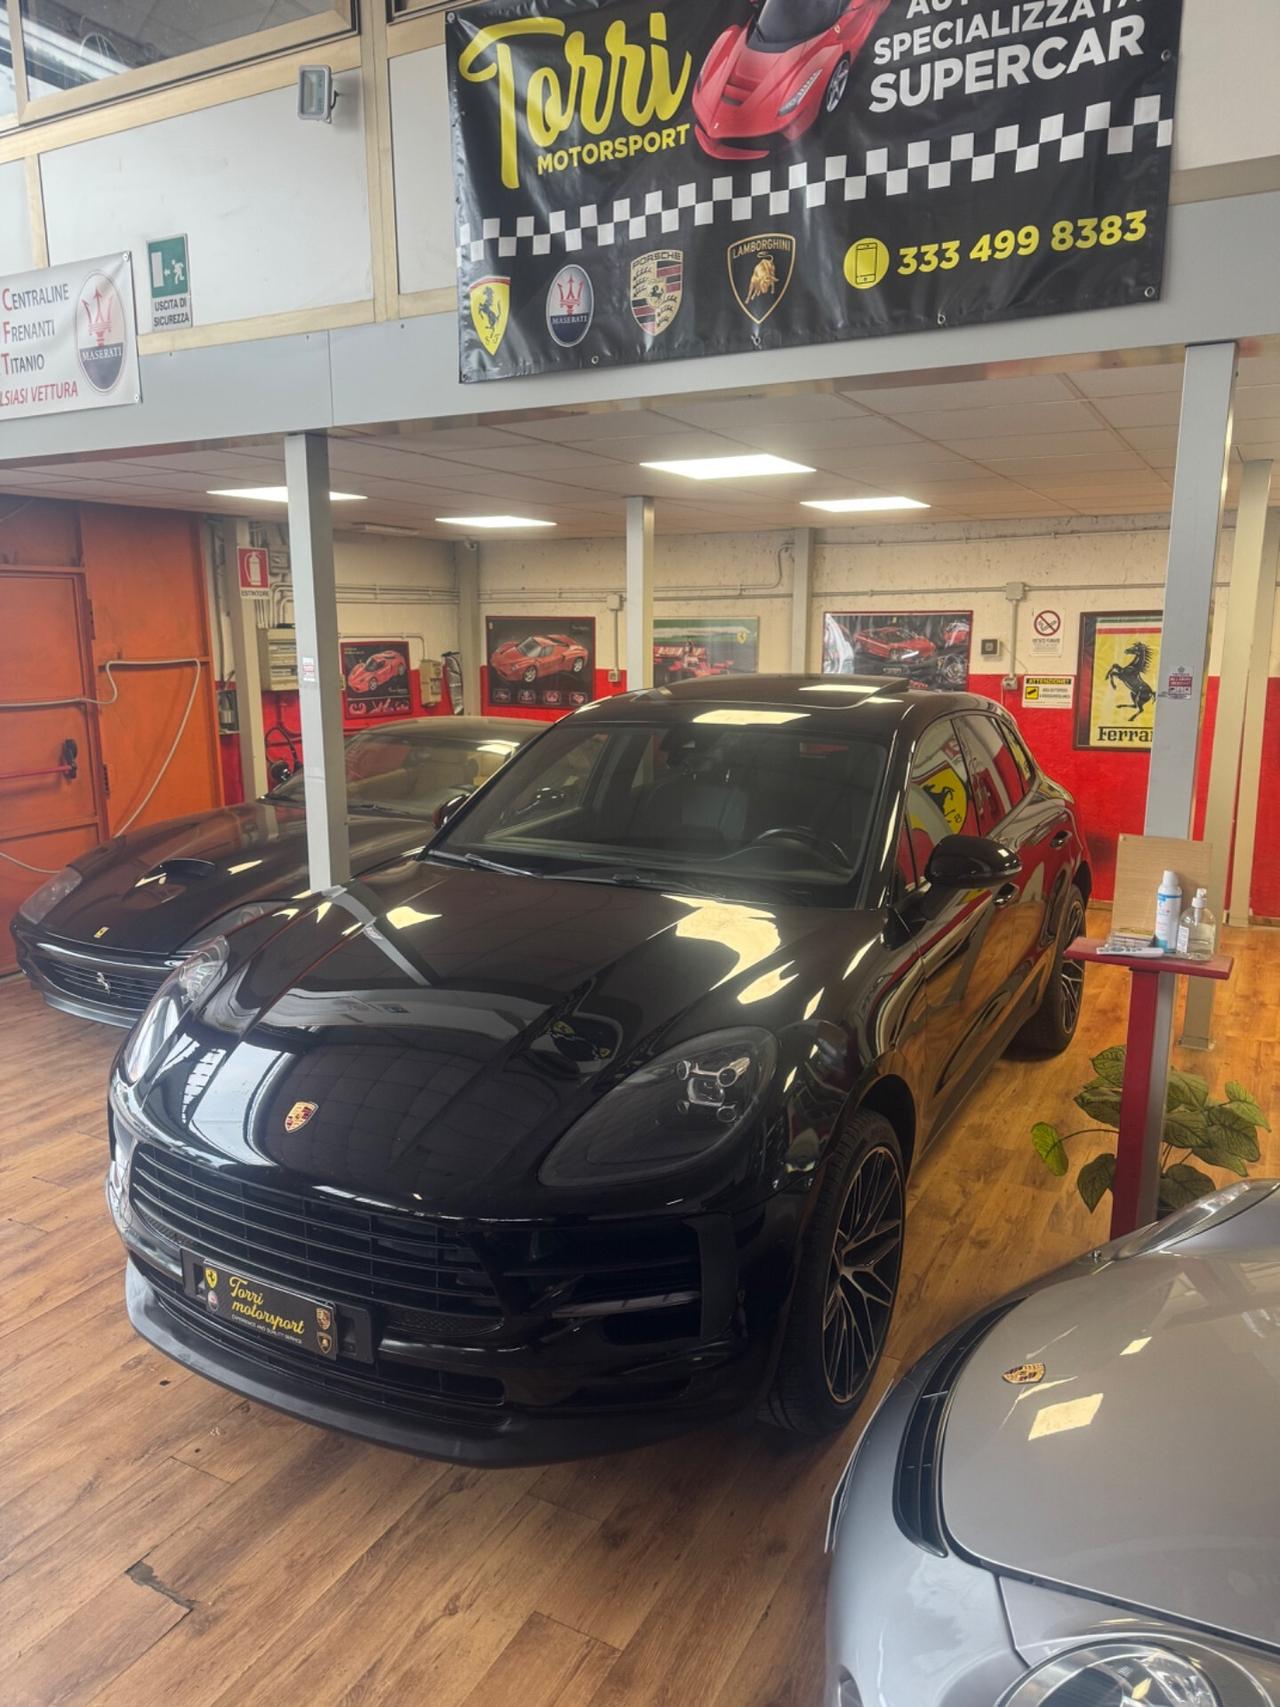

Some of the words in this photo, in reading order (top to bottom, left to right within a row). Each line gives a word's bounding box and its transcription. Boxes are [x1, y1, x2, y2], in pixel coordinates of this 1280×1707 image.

[873, 0, 1143, 65] SPECIALIZZA
[868, 14, 1146, 113] SUPERCAR
[458, 12, 692, 190] Torri
[537, 123, 691, 176] MOTORSPORT
[732, 238, 791, 260] LAMBORGHINI
[897, 240, 960, 276] 333
[969, 225, 1040, 263] 499
[1051, 209, 1148, 252] 8383
[632, 251, 681, 270] PORSCHE
[1, 283, 70, 312] CENTRALINE
[154, 299, 178, 311] USCITA
[179, 297, 187, 308] DI
[2, 319, 56, 344] FRENANTI
[153, 312, 190, 327] SICUREZZA
[551, 315, 589, 326] MASERATI
[0, 352, 45, 376] TITANIO
[82, 346, 122, 361] MASERATI
[31, 381, 79, 403] VETTURA
[229, 1276, 264, 1305] Torri
[231, 1301, 305, 1334] motorsport
